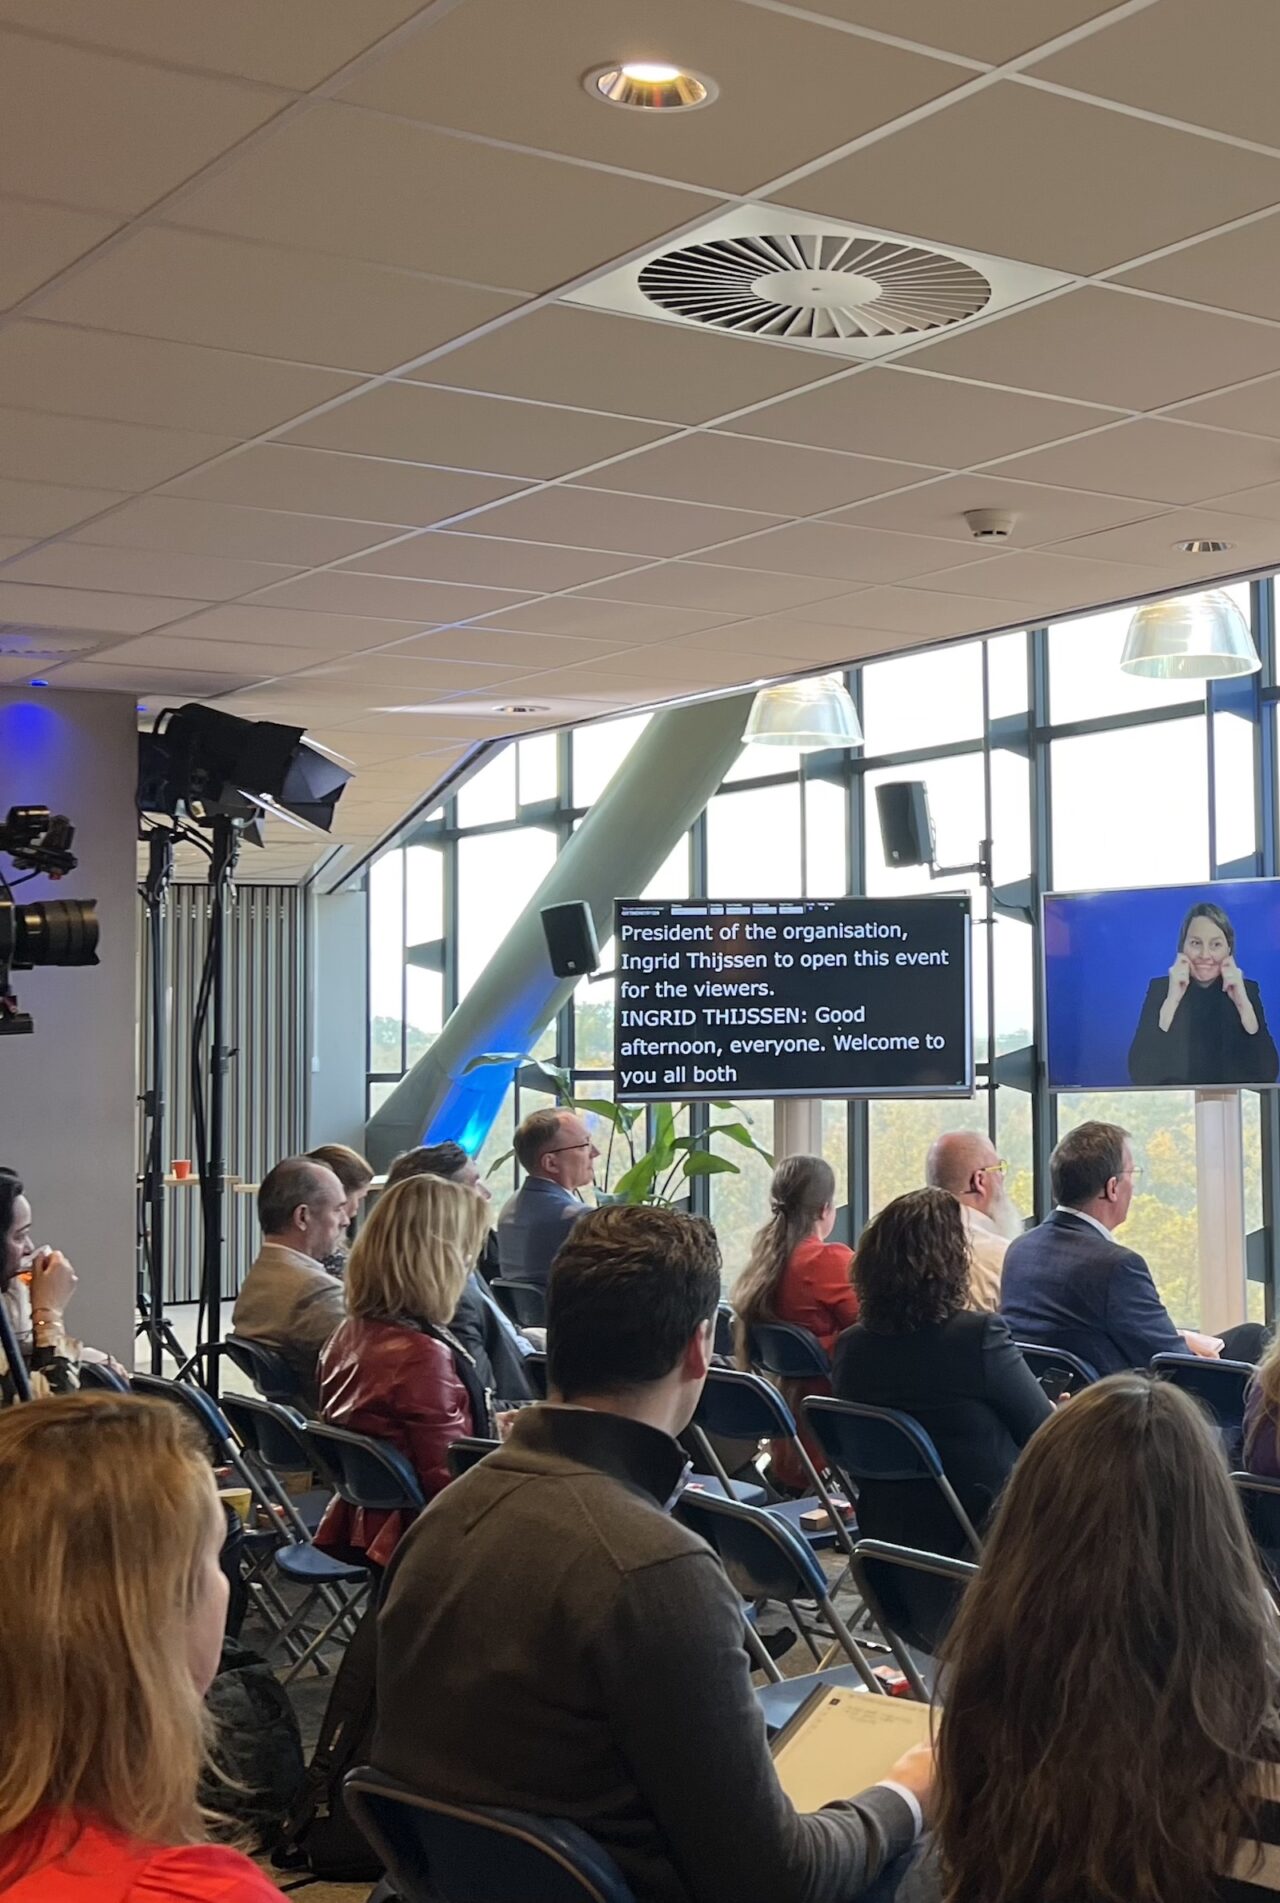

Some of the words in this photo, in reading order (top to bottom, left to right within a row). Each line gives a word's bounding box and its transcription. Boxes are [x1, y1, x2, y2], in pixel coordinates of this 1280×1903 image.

[621, 924, 712, 942] President
[719, 923, 739, 940] of
[745, 923, 777, 940] the
[783, 922, 908, 943] organisation,
[621, 952, 679, 973] Ingrid
[686, 952, 767, 973] Thijssen
[774, 953, 794, 968] to
[800, 954, 847, 971] open
[854, 950, 889, 966] this
[895, 951, 949, 966] event
[621, 982, 649, 999] for
[655, 982, 687, 998] the
[694, 981, 775, 997] viewers.
[621, 1010, 695, 1027] INGRID
[702, 1008, 807, 1026] THIJSSEN:
[815, 1006, 865, 1023] Good
[621, 1039, 722, 1058] afternoon,
[730, 1037, 826, 1056] everyone.
[833, 1034, 919, 1051] Welcome
[925, 1034, 945, 1050] to
[621, 1070, 656, 1087] you
[663, 1067, 686, 1083] all
[694, 1065, 737, 1082] both
